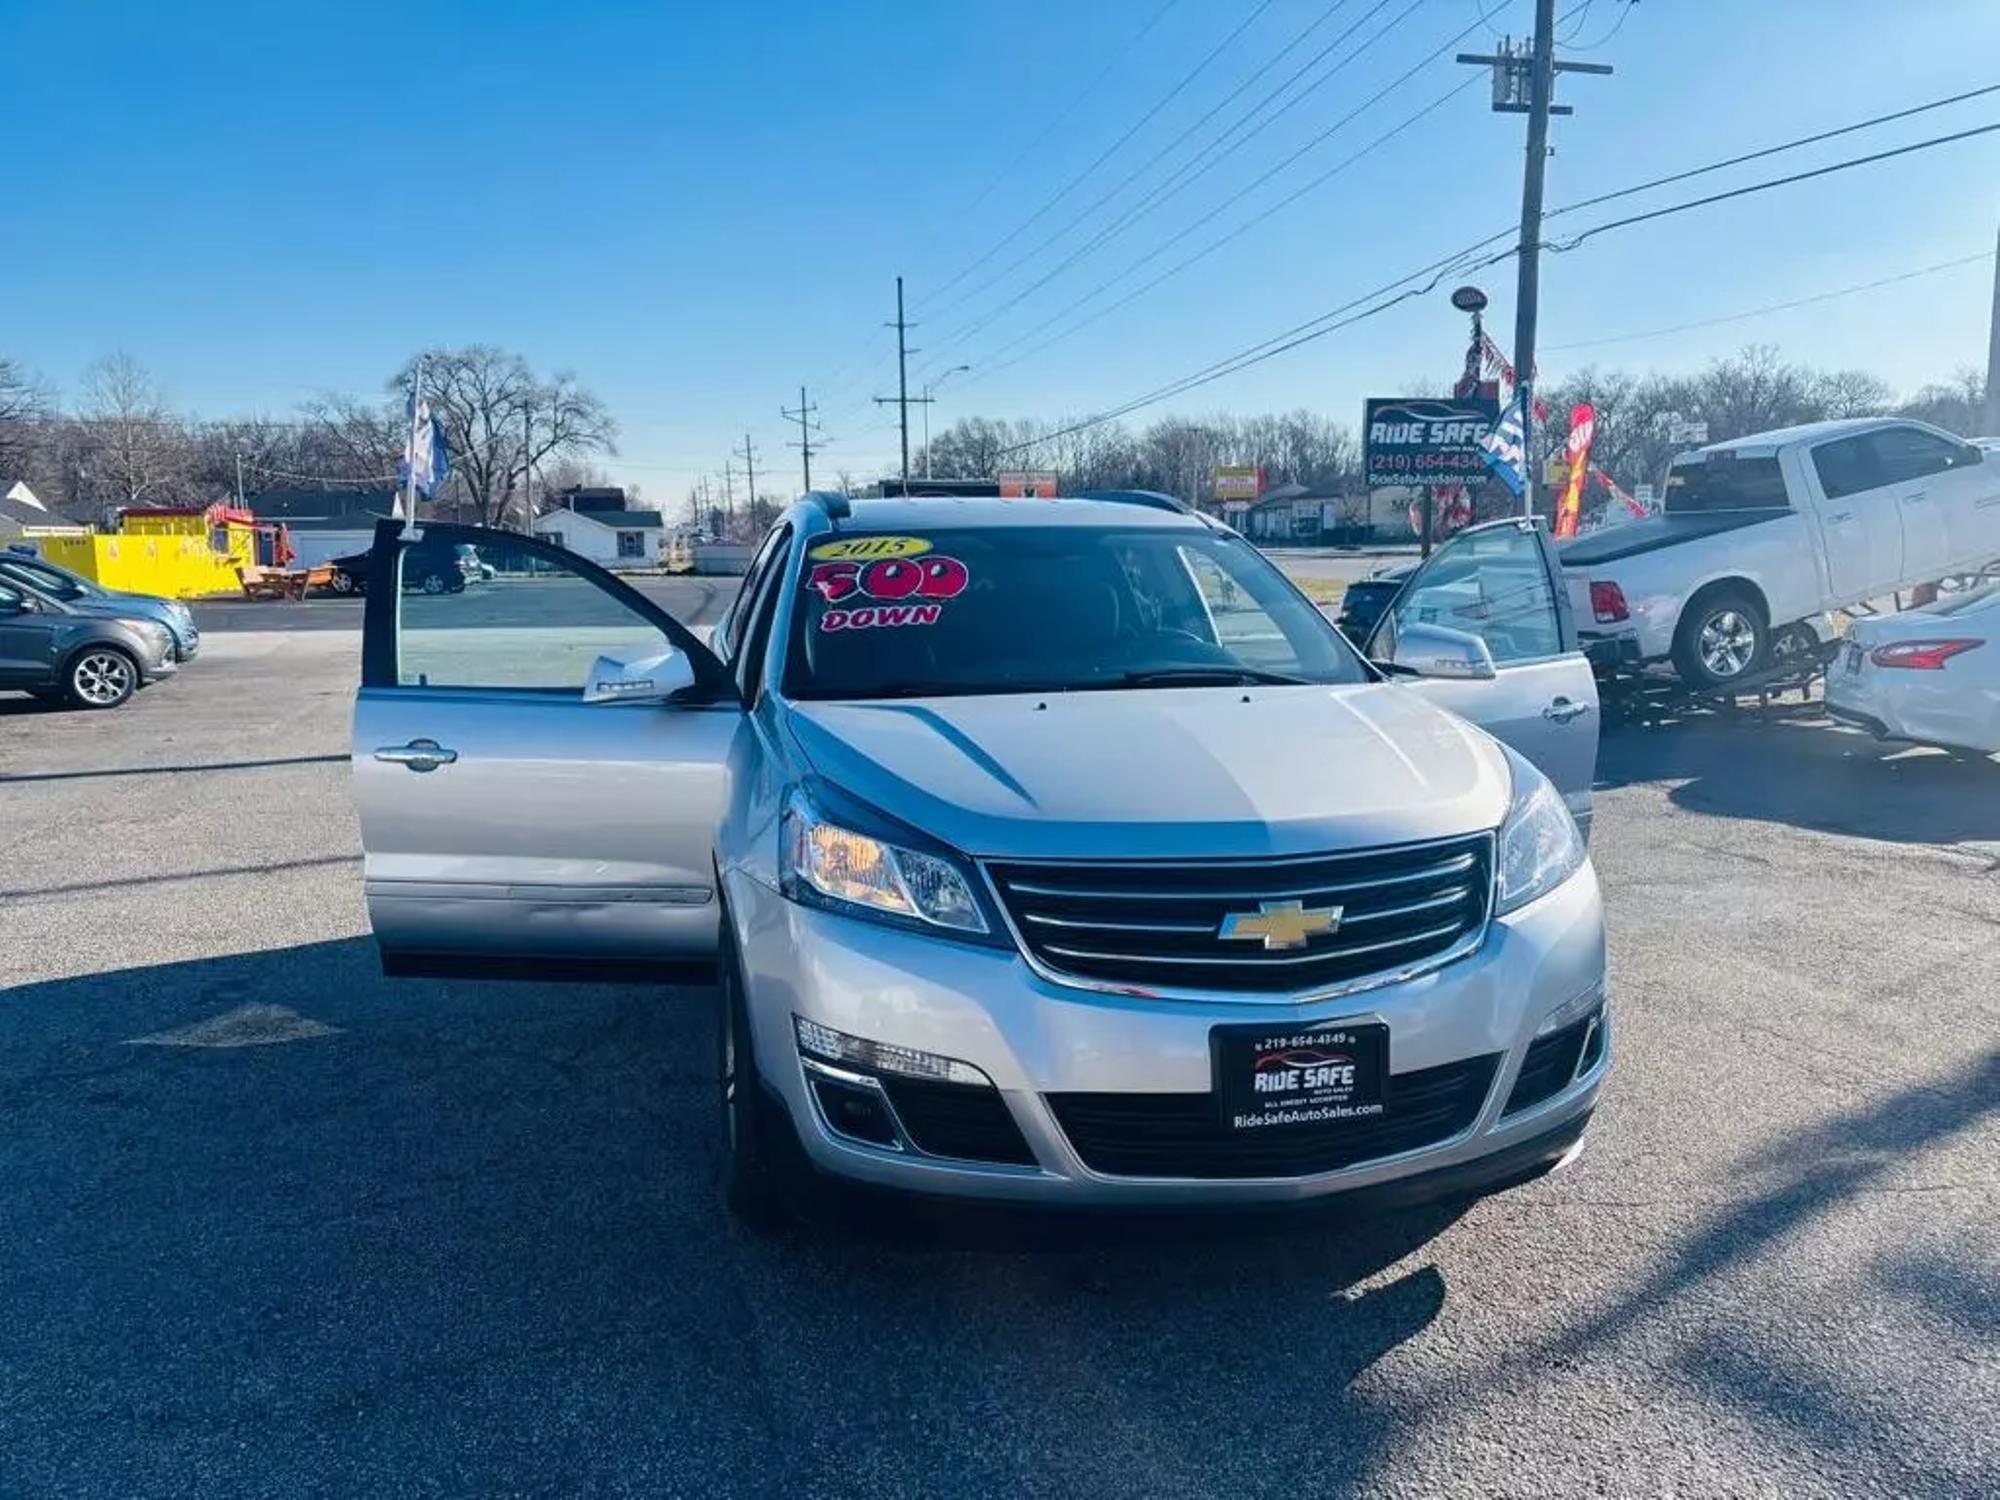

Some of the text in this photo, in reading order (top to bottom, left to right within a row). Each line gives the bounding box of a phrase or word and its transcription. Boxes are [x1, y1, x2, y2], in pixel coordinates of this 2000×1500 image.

[1370, 422, 1490, 444] RIDE SAFE
[1369, 454, 1410, 471] (219)
[1369, 473, 1487, 485] RideSafeAutoSales.com
[831, 540, 907, 557] 2015
[806, 554, 969, 604] 500
[821, 604, 942, 632] DOWN
[1255, 1064, 1356, 1093] RIDE SAFE
[1233, 1104, 1384, 1128] RideSafeAutoSales.com
